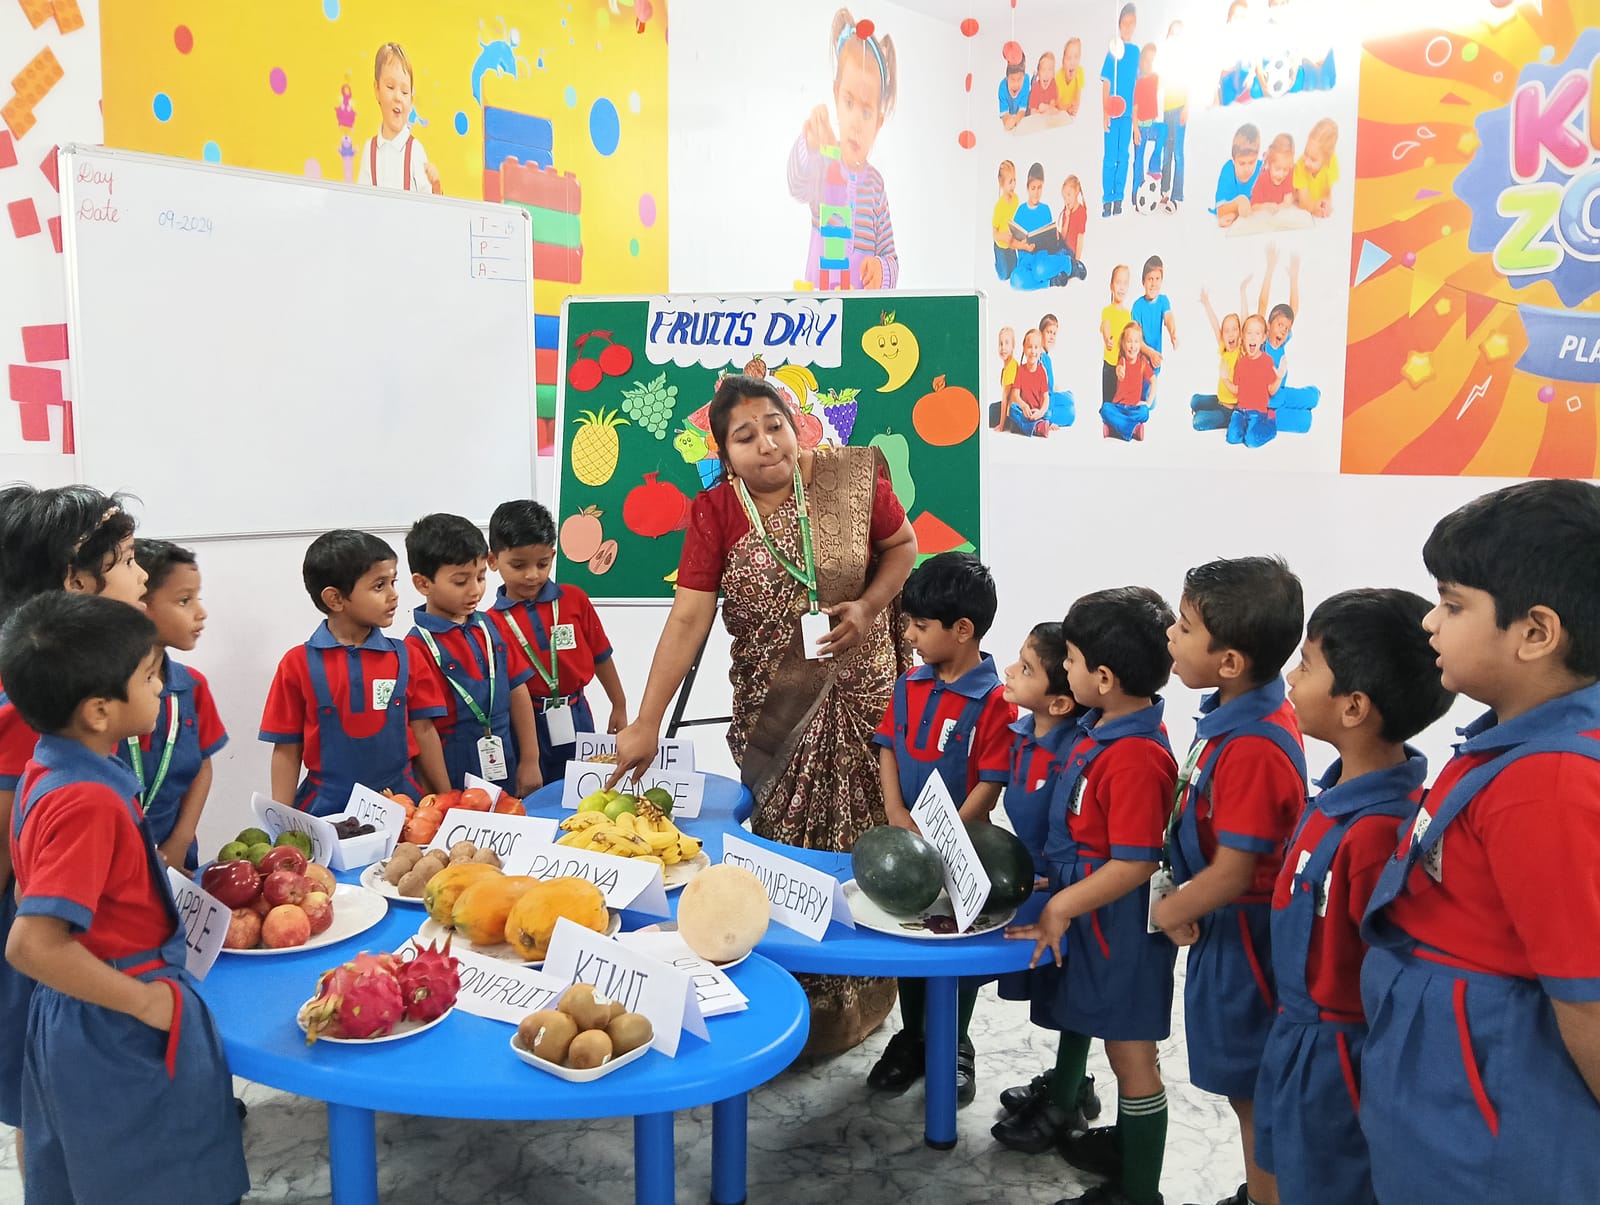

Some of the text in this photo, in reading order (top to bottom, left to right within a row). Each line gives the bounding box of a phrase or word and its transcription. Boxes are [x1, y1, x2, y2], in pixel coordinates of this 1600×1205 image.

[77, 162, 114, 194] Day
[77, 198, 121, 223] Date
[650, 306, 837, 347] FRUITS DAY
[581, 741, 680, 771] PINLE
[576, 772, 690, 809] OANE
[917, 784, 982, 917] WATERMELON
[400, 947, 558, 1010] ONFRUIT
